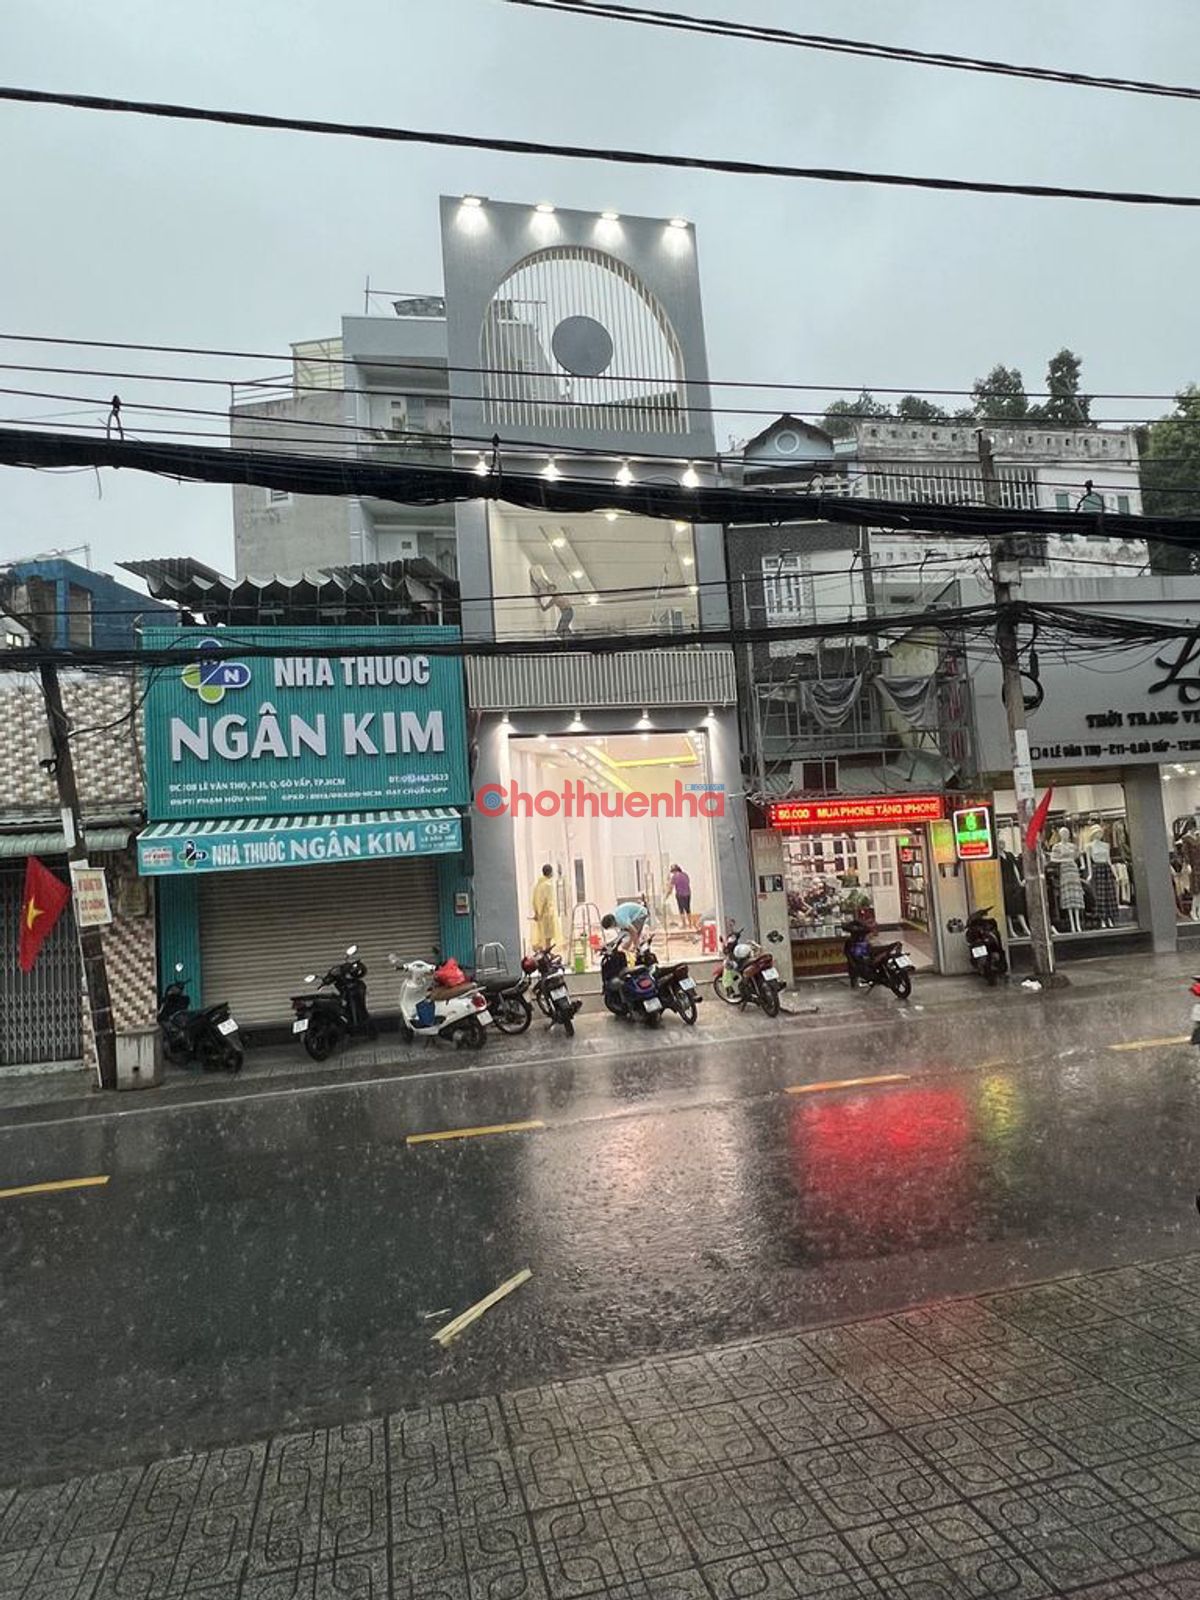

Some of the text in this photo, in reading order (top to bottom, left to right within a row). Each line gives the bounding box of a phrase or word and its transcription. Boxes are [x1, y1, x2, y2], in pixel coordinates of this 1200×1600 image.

[224, 669, 240, 682] N
[171, 702, 445, 762] NGÂN KIM
[1127, 711, 1179, 727] TRANG
[212, 822, 451, 865] NHÀ THUỐC NGÂN KIM 08
